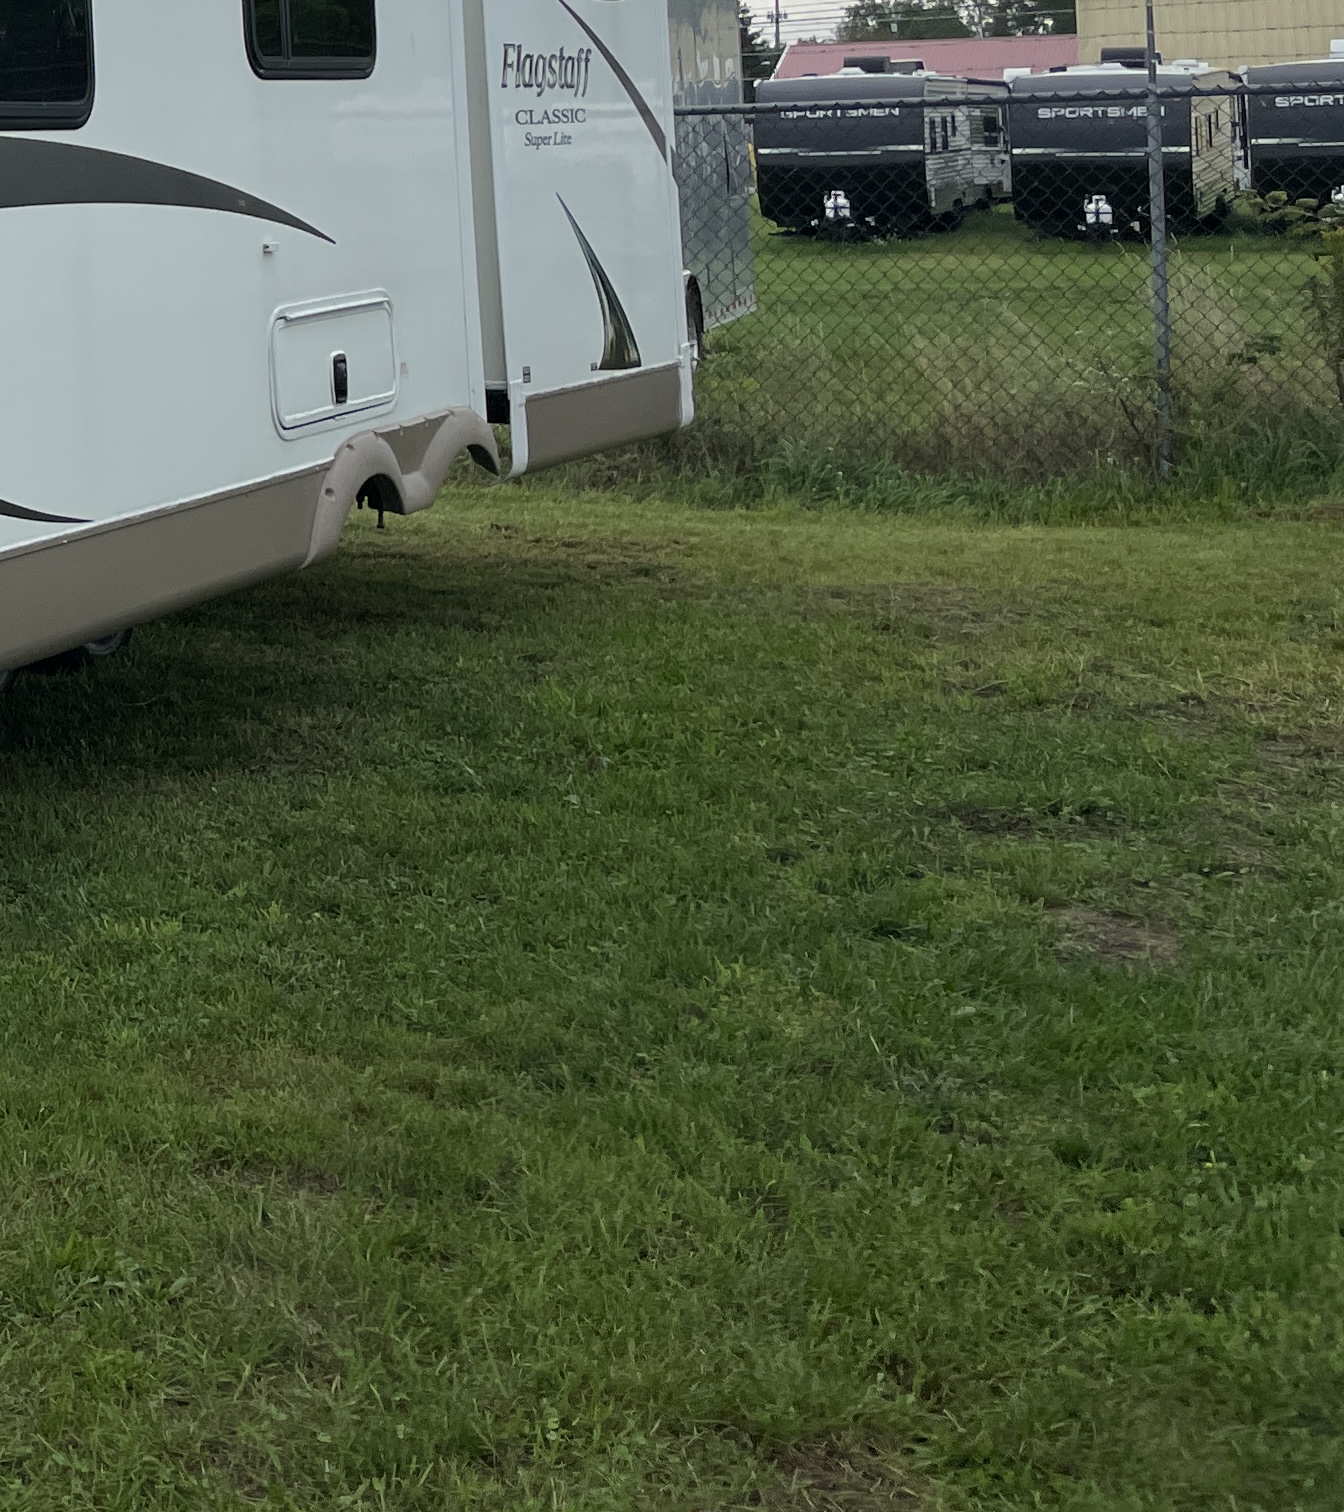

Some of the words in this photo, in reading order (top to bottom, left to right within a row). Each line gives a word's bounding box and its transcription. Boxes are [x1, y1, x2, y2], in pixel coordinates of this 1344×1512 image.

[501, 43, 591, 97] Flagstaff
[515, 108, 586, 125] CLASSIC
[524, 131, 553, 151] Super
[553, 131, 572, 146] Lite
